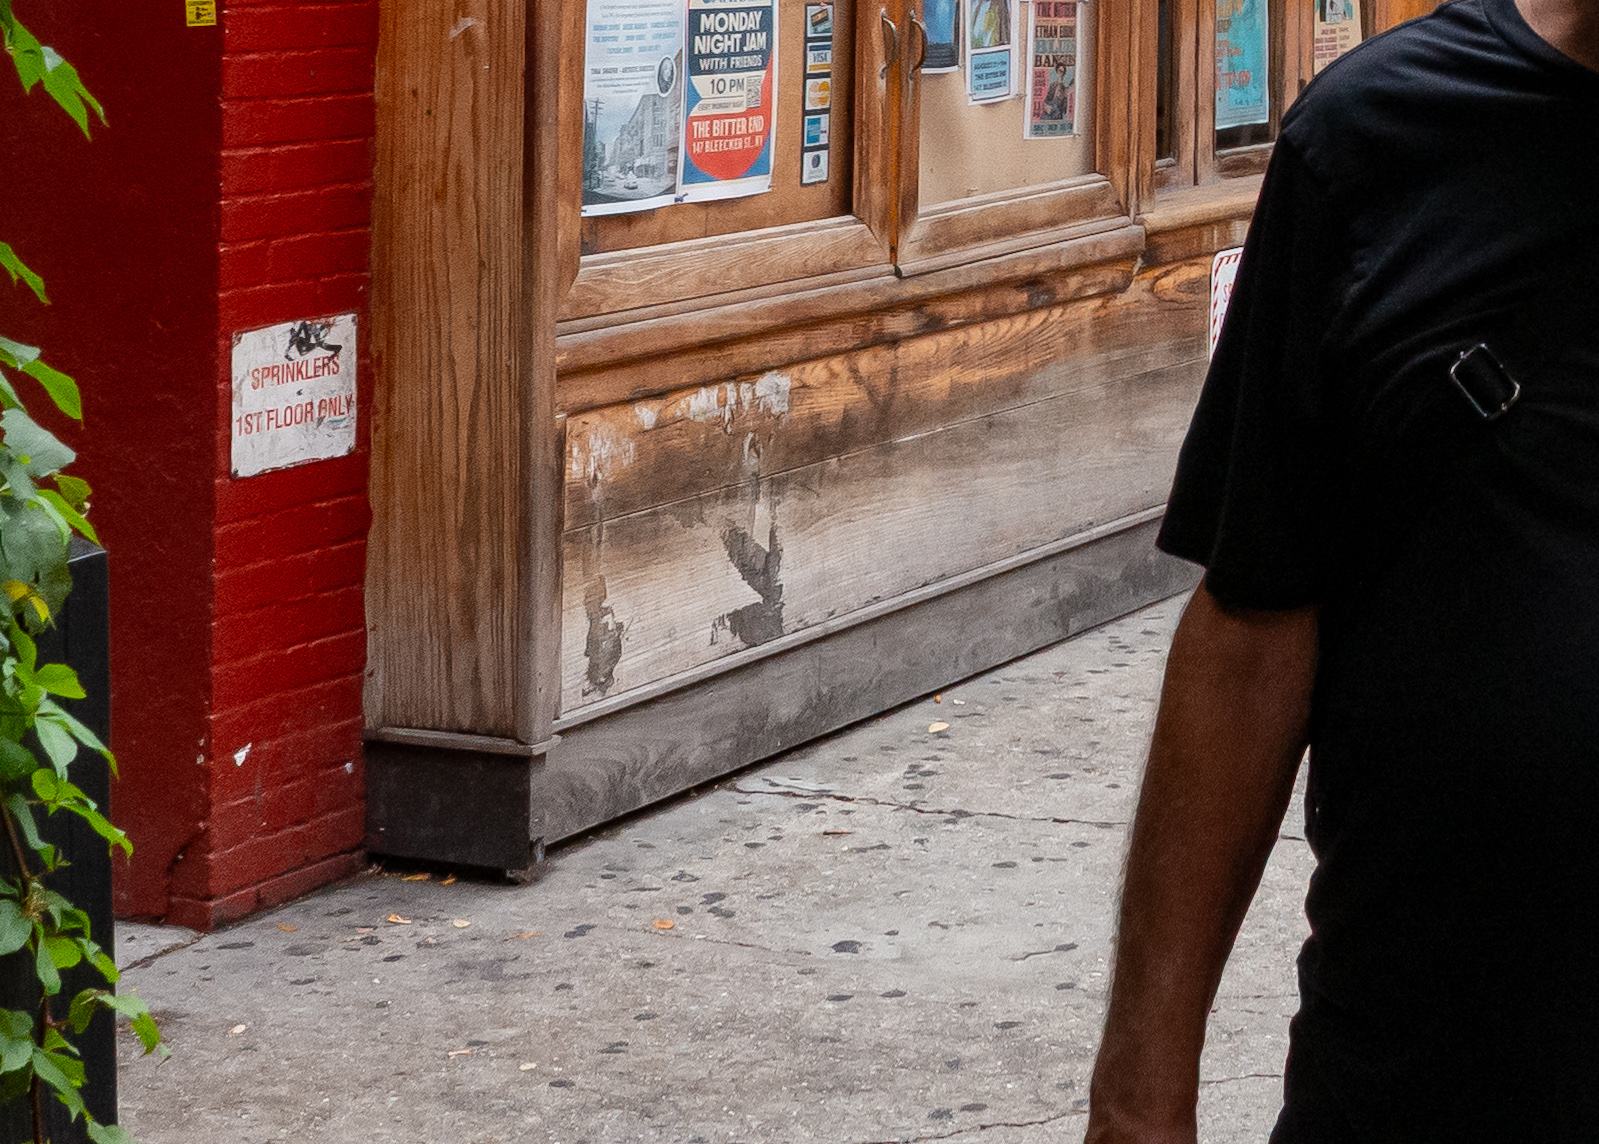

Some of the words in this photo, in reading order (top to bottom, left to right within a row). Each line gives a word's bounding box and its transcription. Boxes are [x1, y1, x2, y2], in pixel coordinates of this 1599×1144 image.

[700, 10, 763, 33] MONDAY
[694, 34, 742, 55] NIGHT
[742, 32, 767, 52] JAM
[699, 57, 728, 71] WITH
[730, 55, 763, 69] FRIENDS
[710, 78, 726, 95] 10
[729, 78, 745, 93] PM
[692, 120, 711, 139] THE
[712, 117, 747, 137] BITTER
[748, 115, 765, 133] END
[692, 141, 704, 154] 147
[704, 138, 743, 153] BLEECKER
[251, 354, 340, 391] SPRINKLERS
[236, 411, 263, 437] 1ST
[265, 399, 314, 431] FLOOR
[317, 393, 354, 418] ONLY
